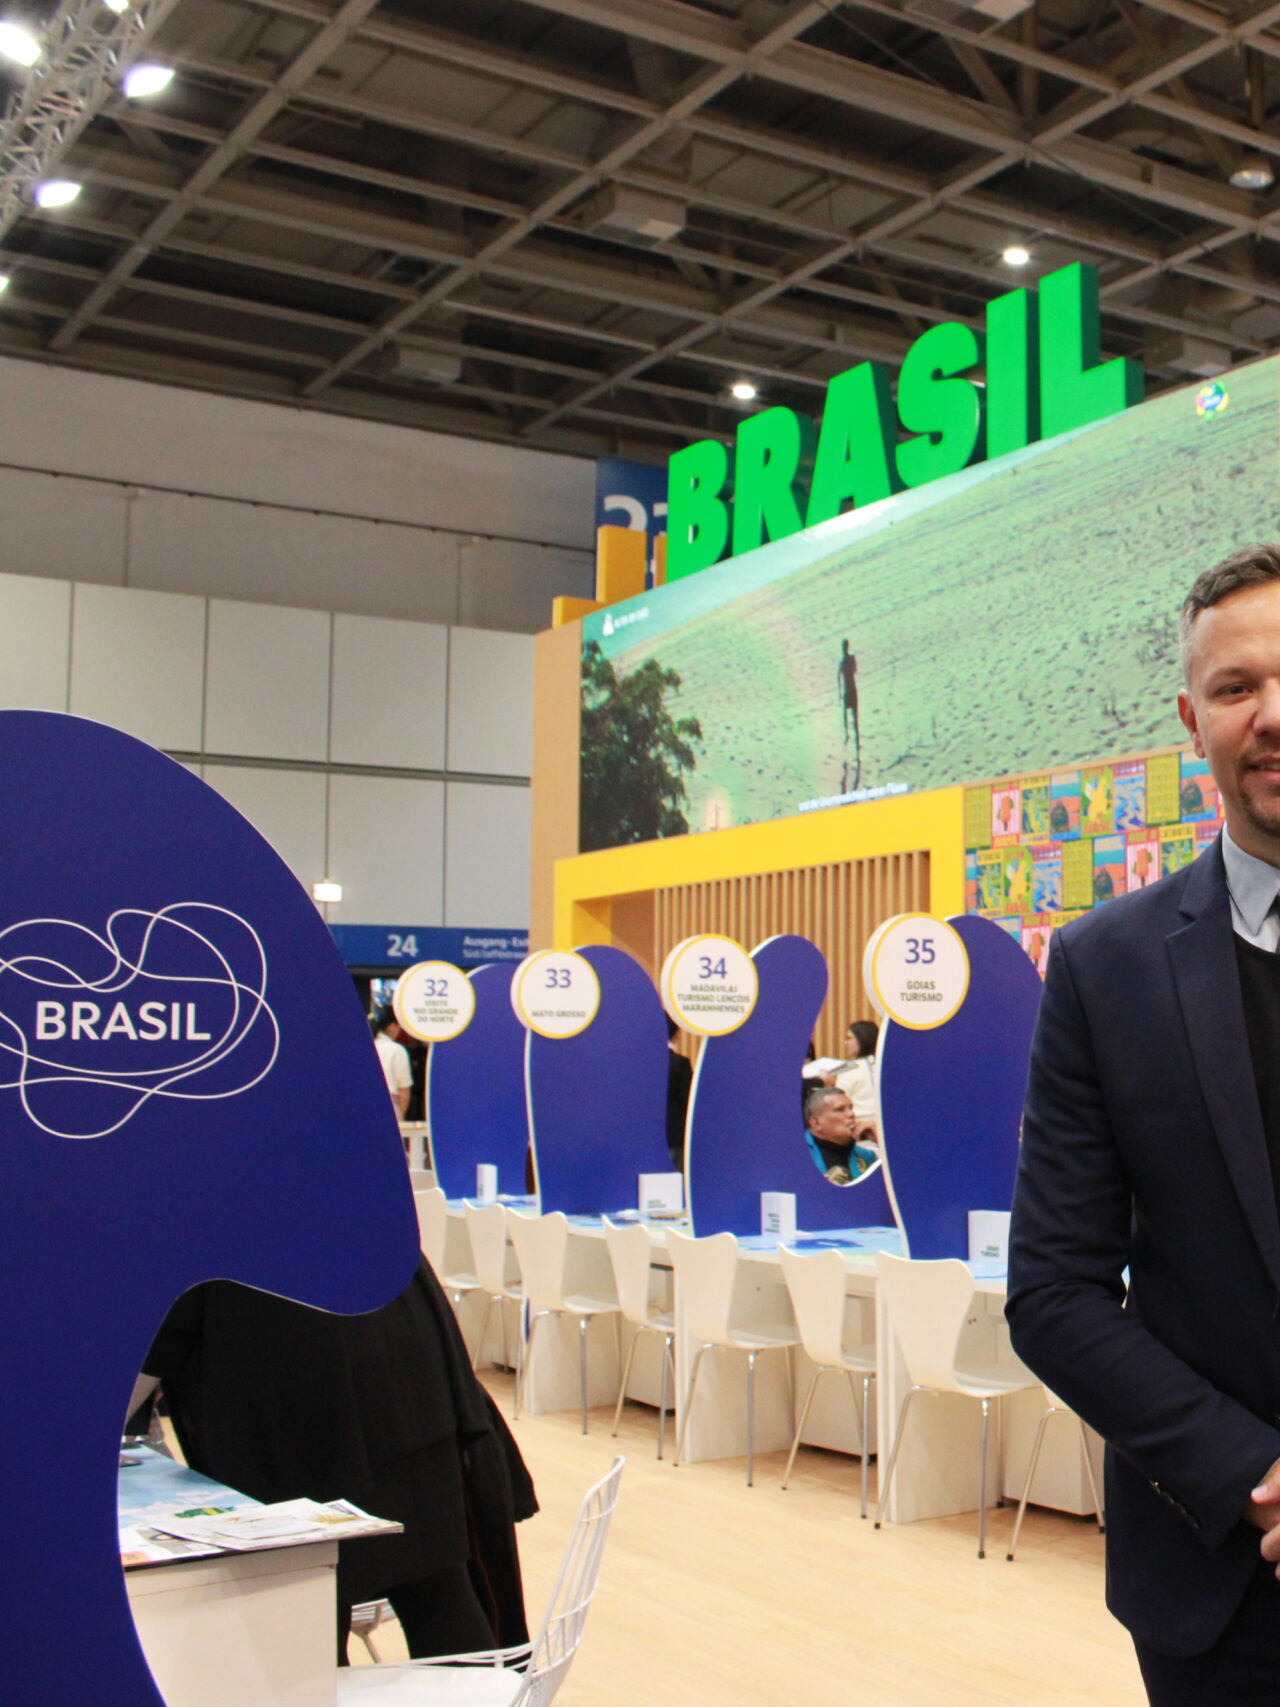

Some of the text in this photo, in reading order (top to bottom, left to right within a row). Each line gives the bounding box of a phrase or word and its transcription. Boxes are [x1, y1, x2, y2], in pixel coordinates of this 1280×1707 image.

[665, 261, 1143, 583] BRASIL
[387, 934, 418, 958] 24
[905, 938, 936, 964] 35
[545, 968, 572, 989] 33
[698, 956, 728, 979] 34
[424, 979, 449, 997] 32
[906, 980, 936, 990] GOIAS
[677, 993, 715, 1002] TURISMO
[900, 992, 943, 1002] TURISMO
[36, 1001, 211, 1041] BRASIL
